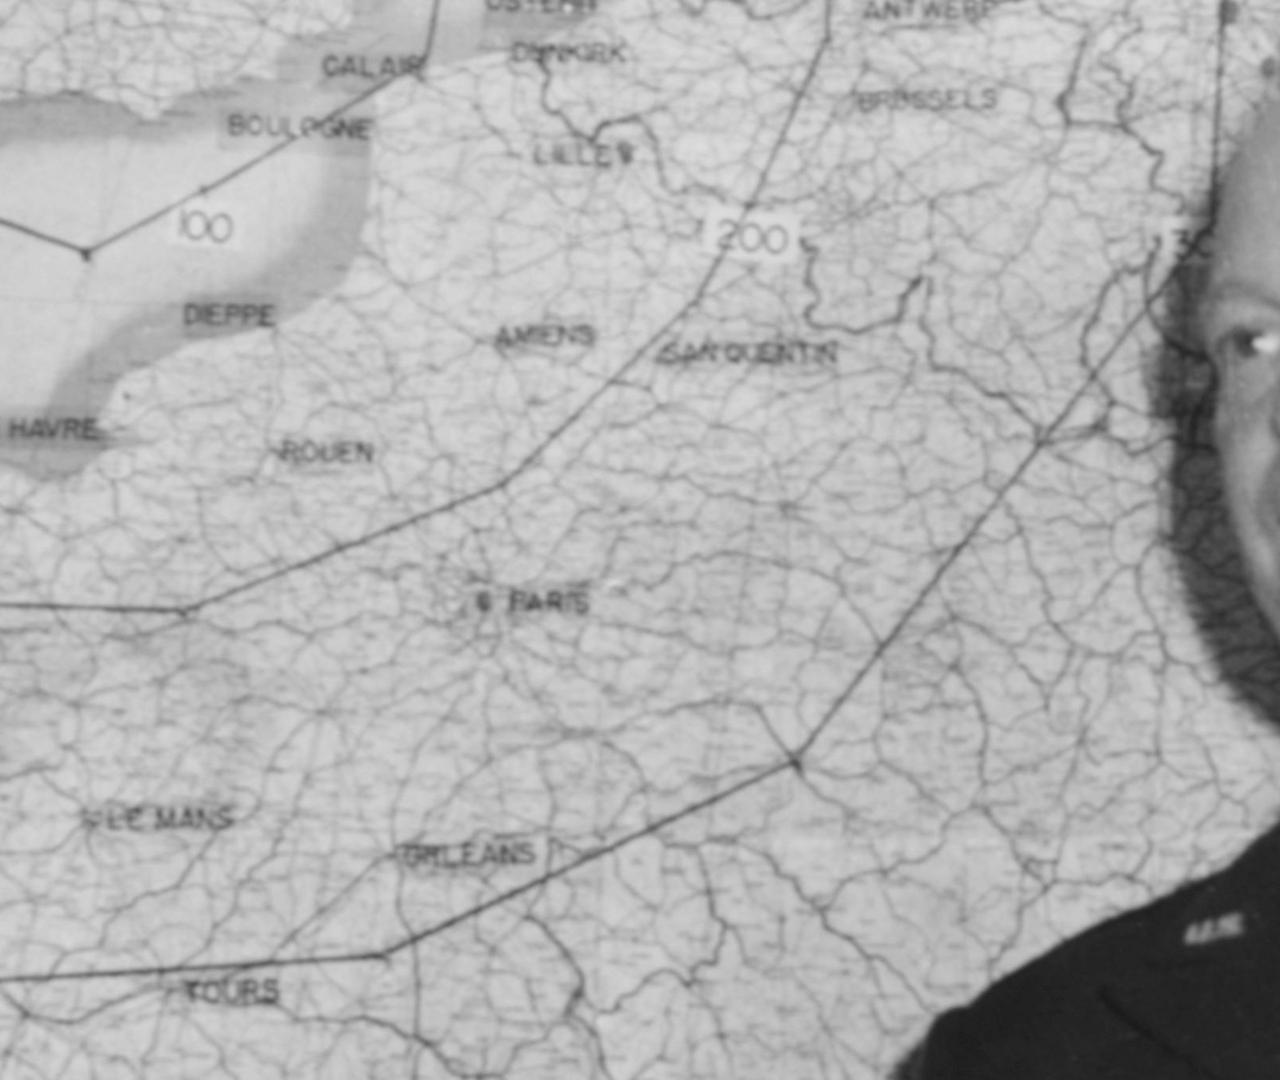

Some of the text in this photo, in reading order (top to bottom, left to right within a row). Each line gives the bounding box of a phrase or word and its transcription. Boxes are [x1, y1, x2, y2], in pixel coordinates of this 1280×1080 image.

[179, 209, 234, 244] 100
[717, 217, 788, 254] 200
[183, 301, 276, 328] DIEPPE
[6, 416, 101, 441] HAVRE
[281, 439, 374, 463] ROUEN
[508, 588, 590, 615] PARIS
[106, 804, 236, 832] LE MANS
[184, 979, 280, 1005] TOURS
